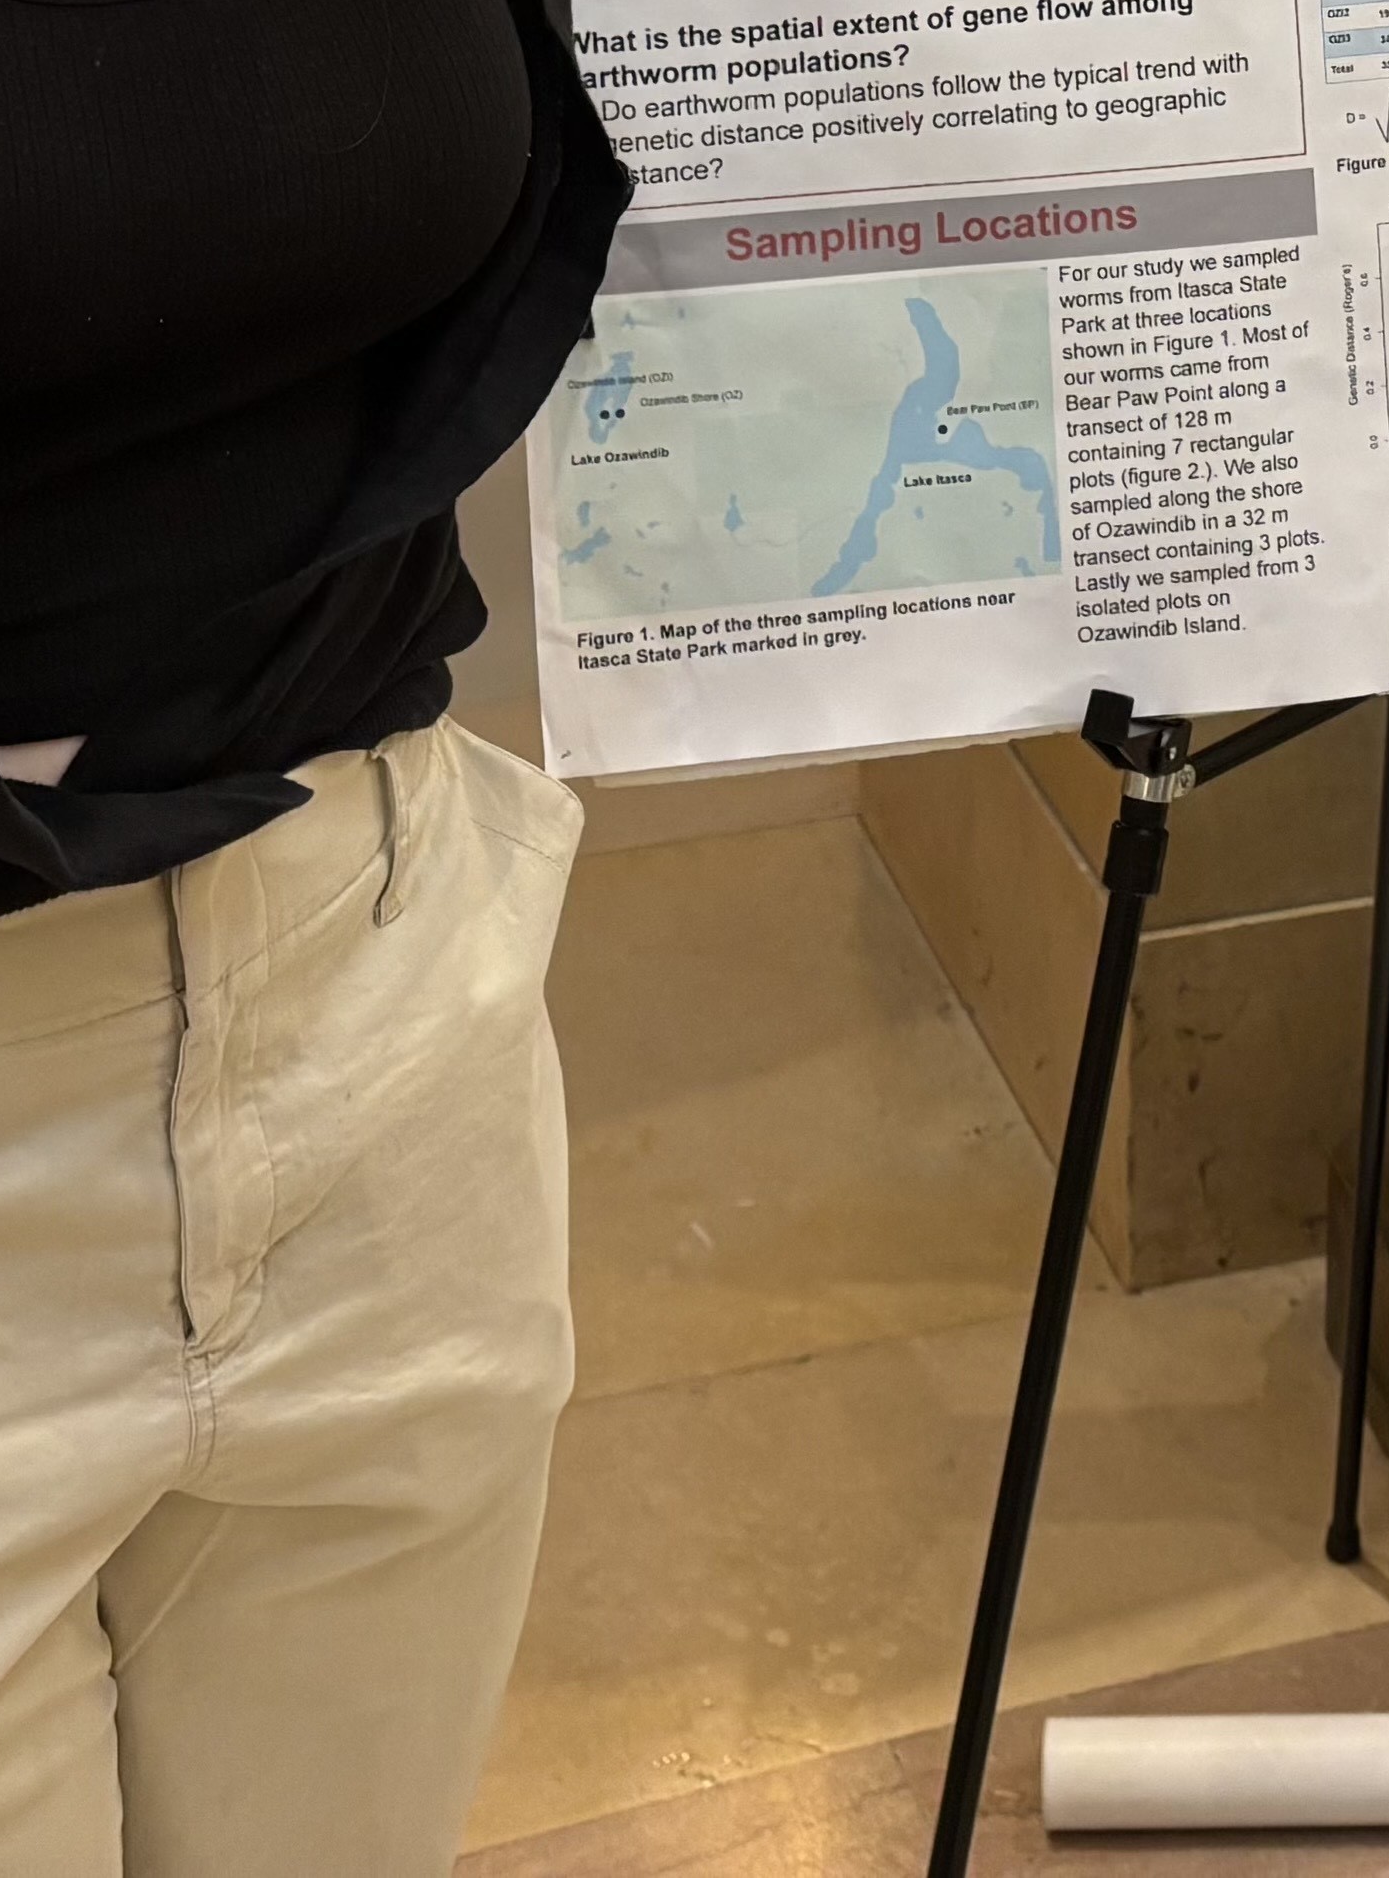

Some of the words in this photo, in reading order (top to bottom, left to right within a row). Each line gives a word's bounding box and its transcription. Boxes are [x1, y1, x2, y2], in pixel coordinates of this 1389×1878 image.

[1336, 157, 1387, 175] Figure
[727, 216, 922, 263] Sampling
[937, 203, 1137, 244] Locations
[570, 454, 602, 467] Lake
[603, 447, 670, 463] Ozawindib
[903, 475, 933, 488] Lake
[935, 473, 972, 485] Itasca
[1077, 618, 1178, 644] Ozawindib
[1183, 613, 1247, 635] Island.
[578, 653, 632, 670] Itasca
[636, 646, 682, 664] State
[686, 640, 728, 659] Park
[731, 632, 798, 654] marked
[802, 631, 819, 647] in
[823, 629, 867, 648] grey.
